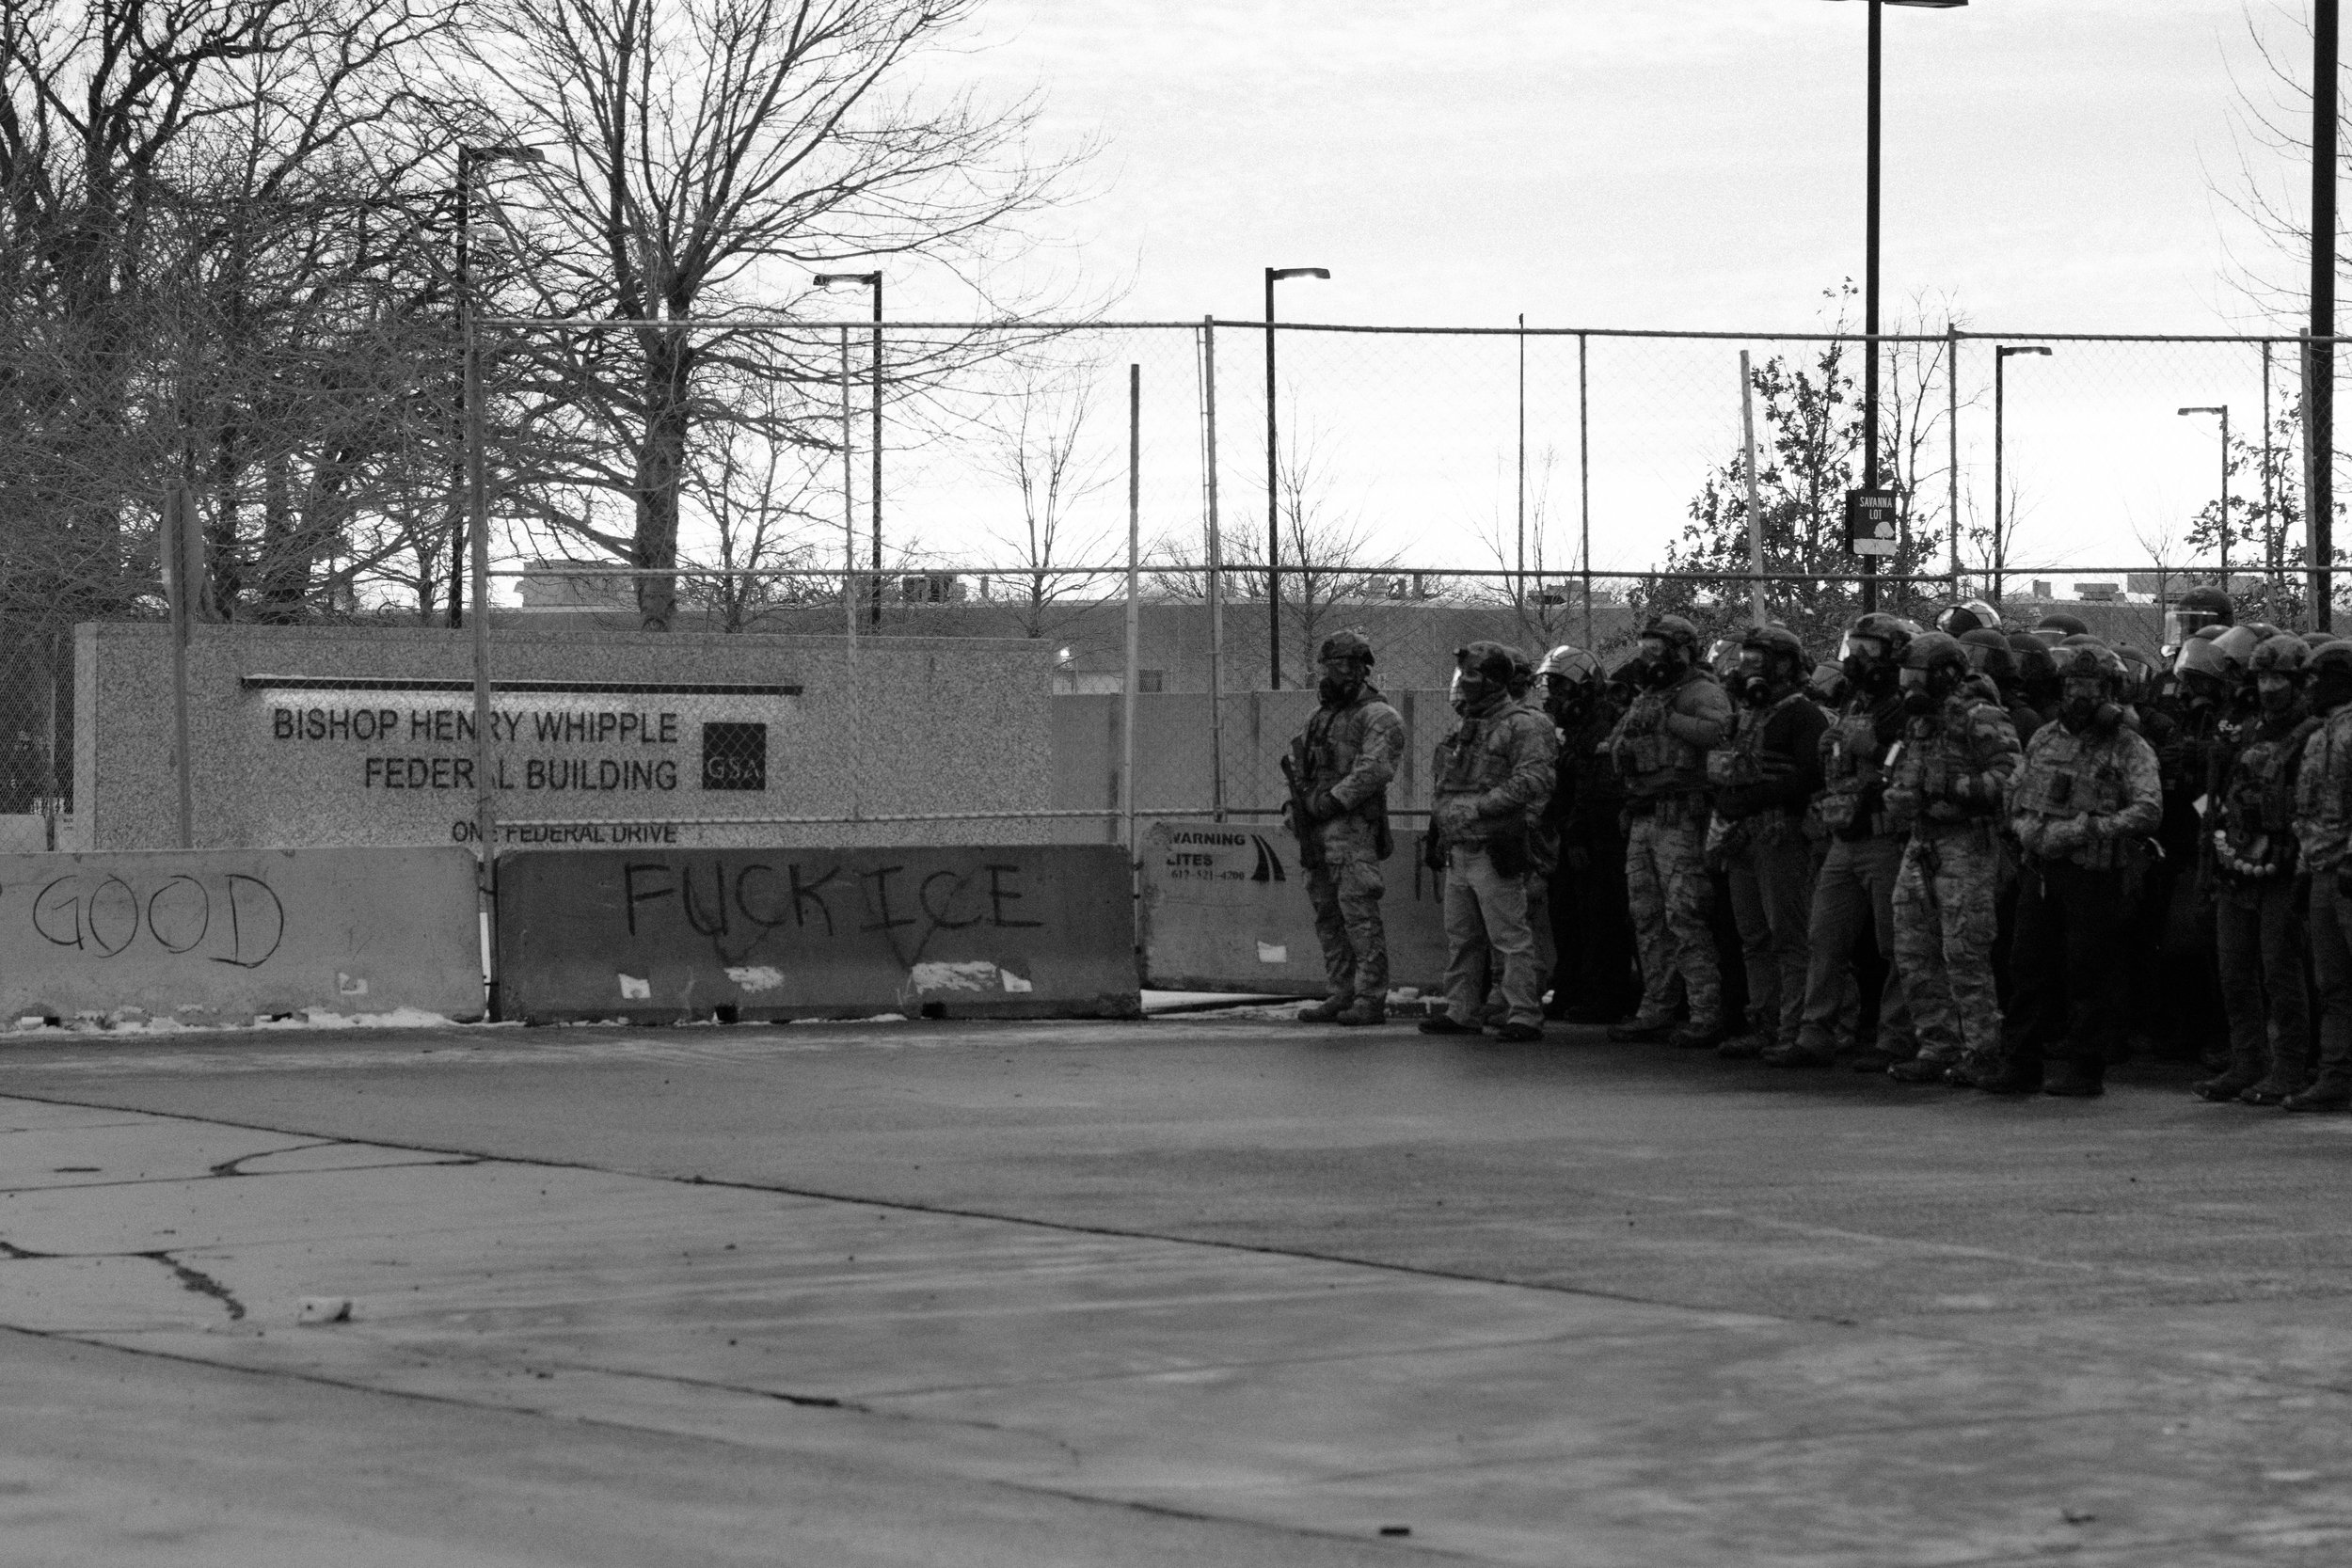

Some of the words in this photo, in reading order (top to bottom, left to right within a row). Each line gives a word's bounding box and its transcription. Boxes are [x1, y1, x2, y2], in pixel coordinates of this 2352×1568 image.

[1859, 496, 1893, 508] SAVANNA
[1869, 509, 1883, 520] LOT
[274, 708, 399, 741] BISHOP
[533, 711, 678, 744] WHIPPLE
[364, 757, 515, 790] FEDERL
[526, 759, 678, 791] BUILDING
[707, 756, 760, 779] GSA
[506, 825, 606, 844] FEDERAL
[612, 824, 677, 844] DRIVE
[624, 860, 841, 938] FUCK
[859, 863, 1045, 931] ICE
[32, 873, 284, 969] GOOD
